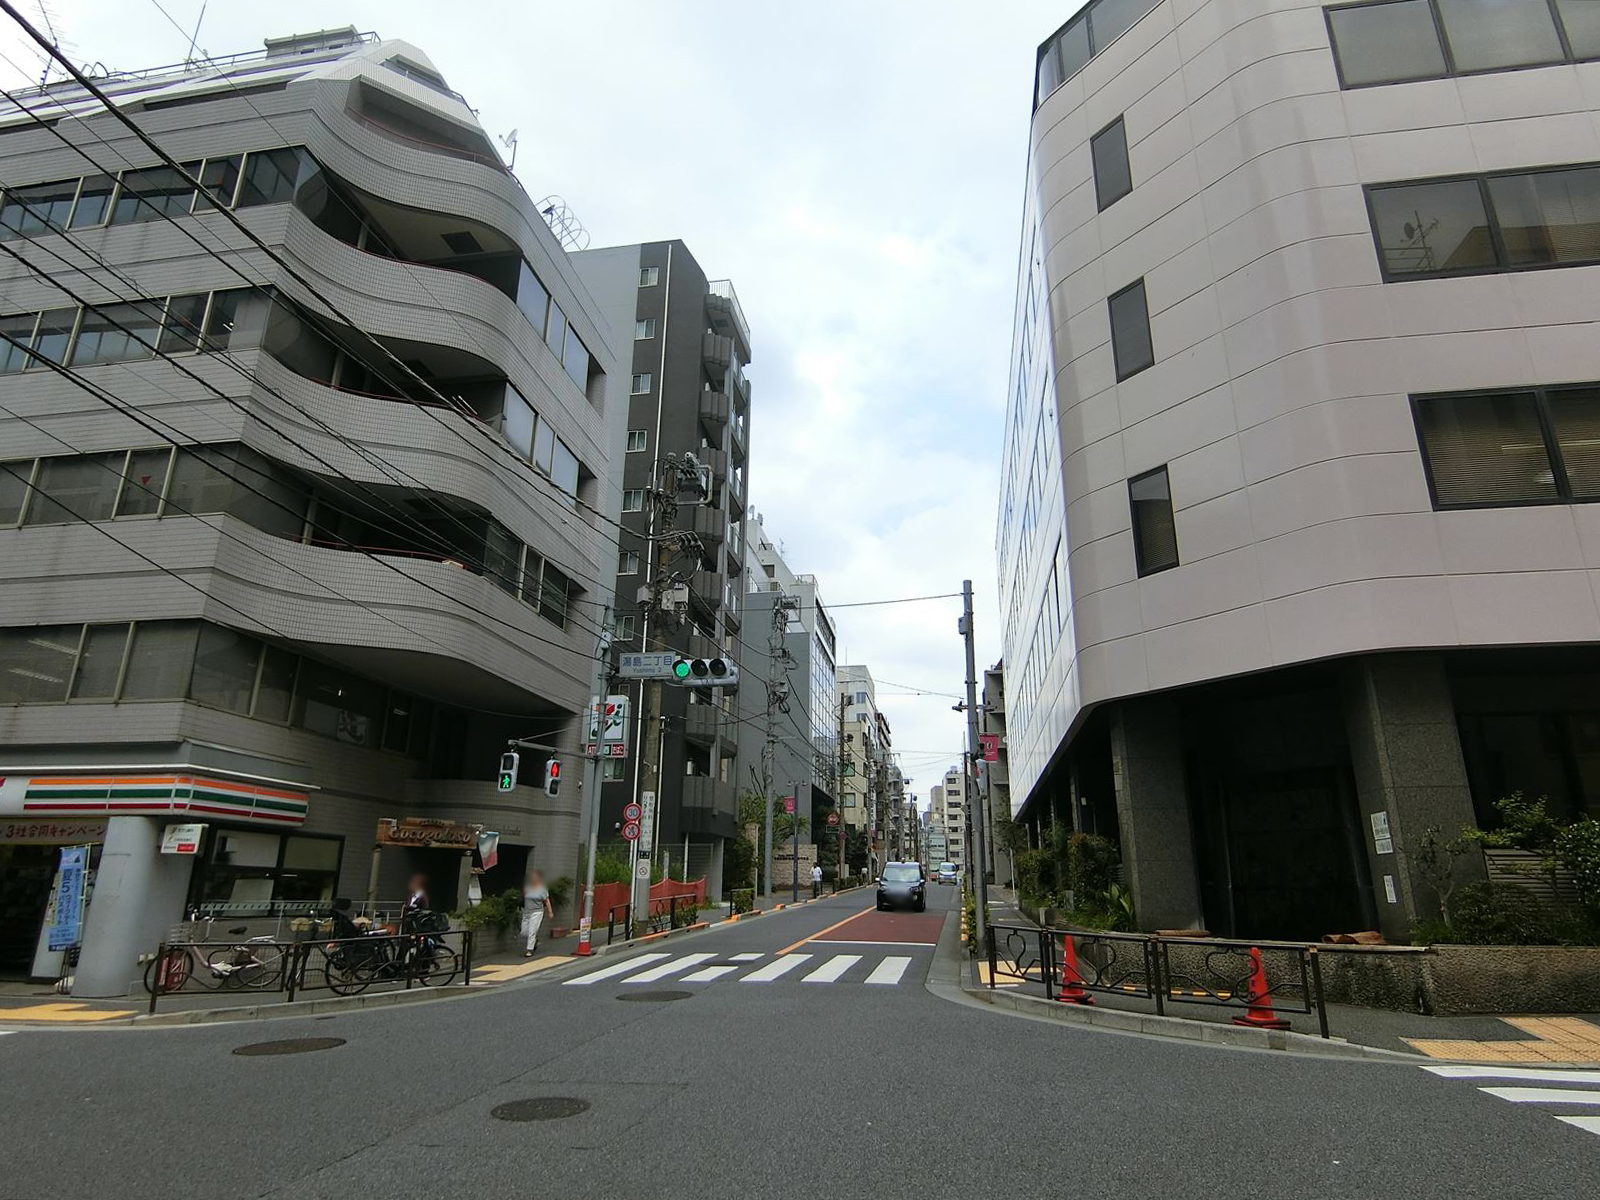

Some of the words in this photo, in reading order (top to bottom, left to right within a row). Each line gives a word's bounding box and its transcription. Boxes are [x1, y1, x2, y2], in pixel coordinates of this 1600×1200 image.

[623, 655, 672, 667] 湯島二丁目
[628, 807, 638, 817] 30
[6, 824, 105, 838] 3社合同キャンペーン
